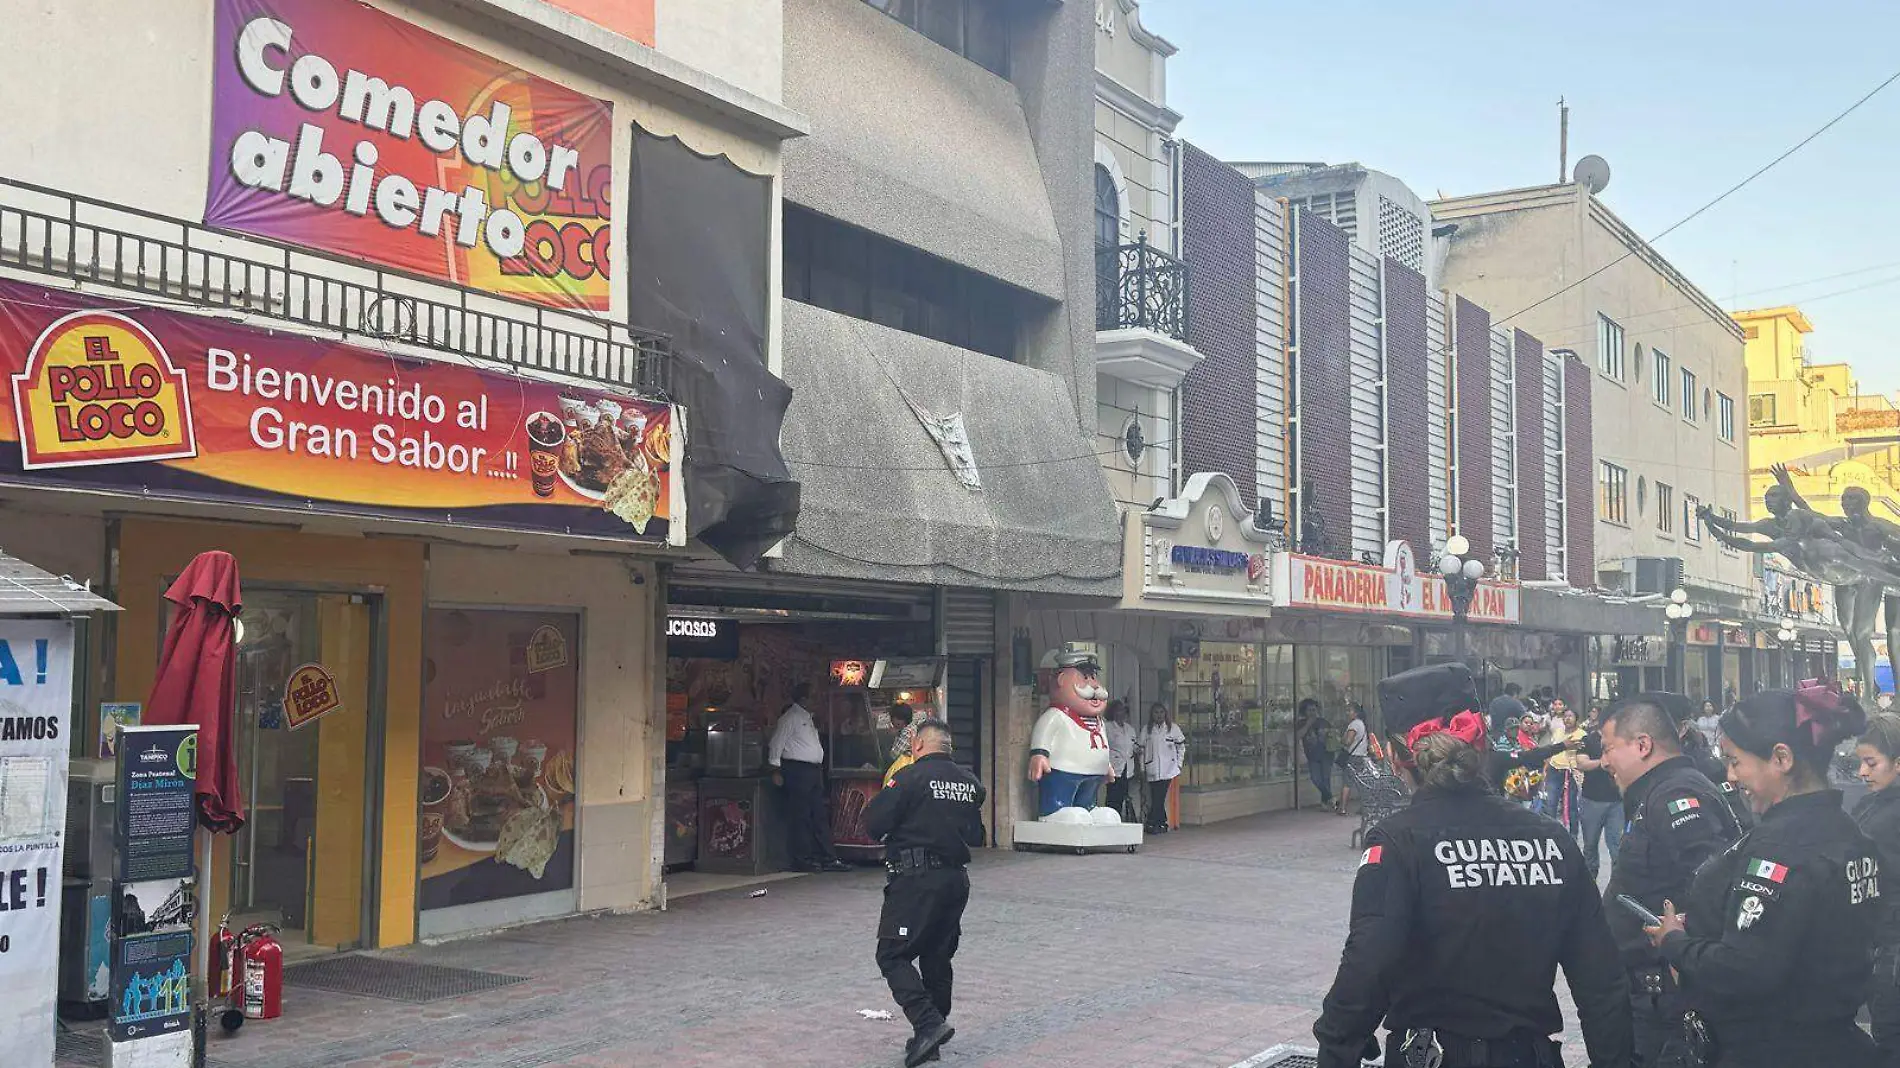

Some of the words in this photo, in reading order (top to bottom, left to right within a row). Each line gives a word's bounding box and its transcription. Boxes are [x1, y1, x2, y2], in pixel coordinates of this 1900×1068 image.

[238, 17, 578, 190] Comedor
[231, 123, 525, 257] abierto
[83, 336, 119, 361] EL
[48, 363, 162, 403] POLLO
[207, 348, 445, 423] Bienvenido
[456, 394, 488, 431] al
[54, 400, 165, 442] LOCO
[249, 406, 357, 459] Gran
[1304, 563, 1387, 606] PANADERIA
[1422, 580, 1436, 611] EL
[1483, 588, 1505, 617] PAN
[296, 691, 330, 716] LOCO
[929, 780, 976, 793] GUARDIA
[933, 790, 974, 802] ESTATAL
[1434, 838, 1563, 864] GUARDIA
[1446, 862, 1563, 888] ESTATAL
